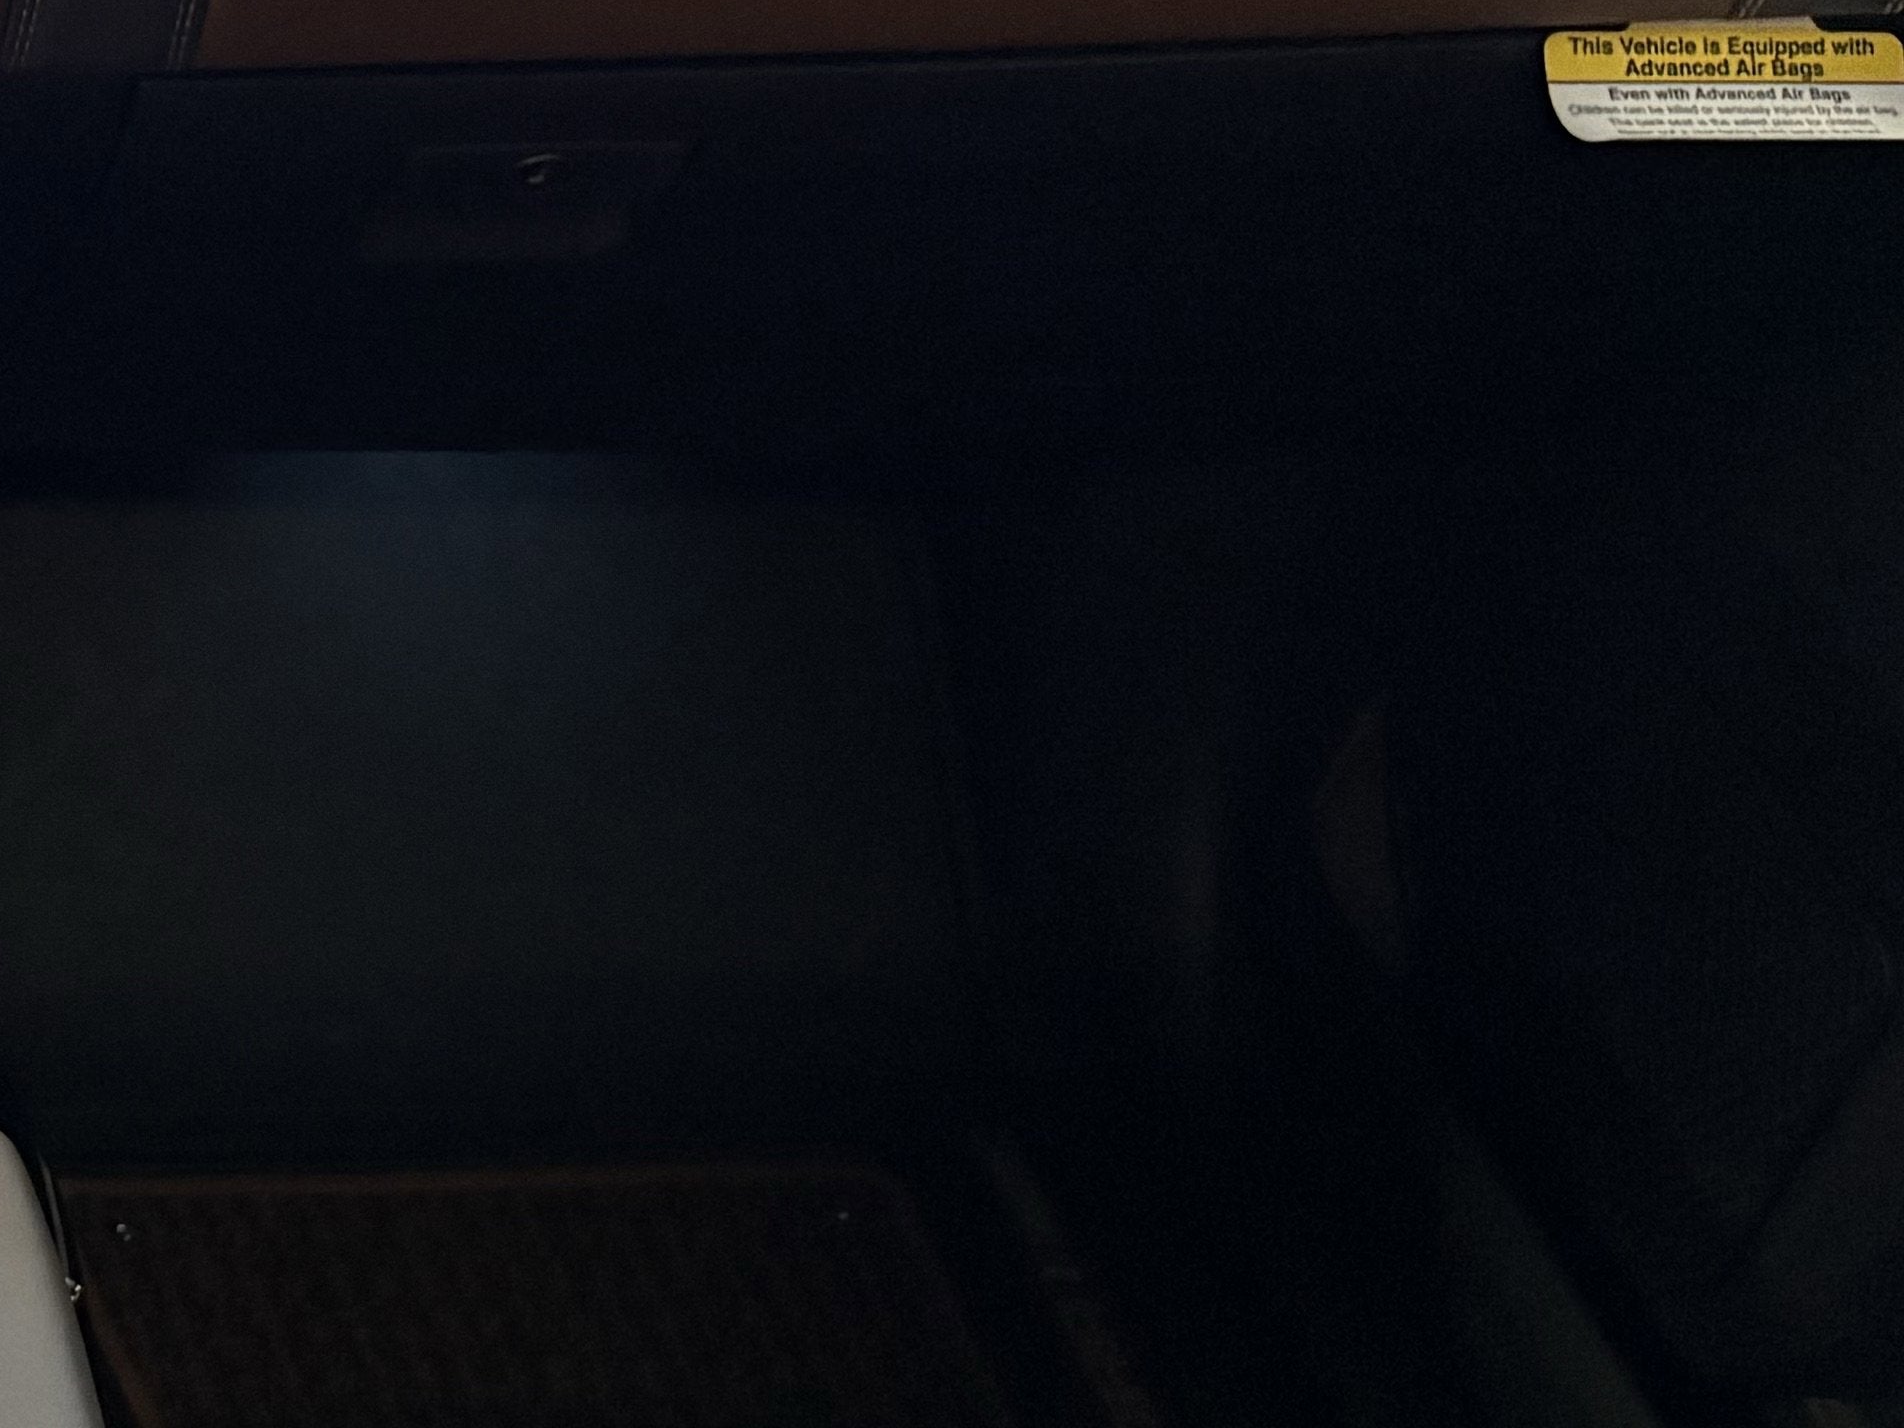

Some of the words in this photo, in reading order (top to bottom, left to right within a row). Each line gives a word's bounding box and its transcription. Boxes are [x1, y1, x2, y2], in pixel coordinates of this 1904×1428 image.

[1568, 36, 1613, 55] This
[1619, 36, 1696, 55] Vehicle
[1703, 36, 1721, 55] is
[1728, 36, 1825, 60] Equipped
[1830, 36, 1874, 55] with
[1625, 59, 1730, 77] Advanced
[1737, 59, 1765, 77] Air
[1773, 59, 1824, 82] Bags
[1608, 88, 1650, 101] Even
[1654, 88, 1690, 101] with
[1695, 88, 1775, 101] Advanced
[1781, 88, 1805, 101] Air
[1810, 88, 1851, 103] Bags
